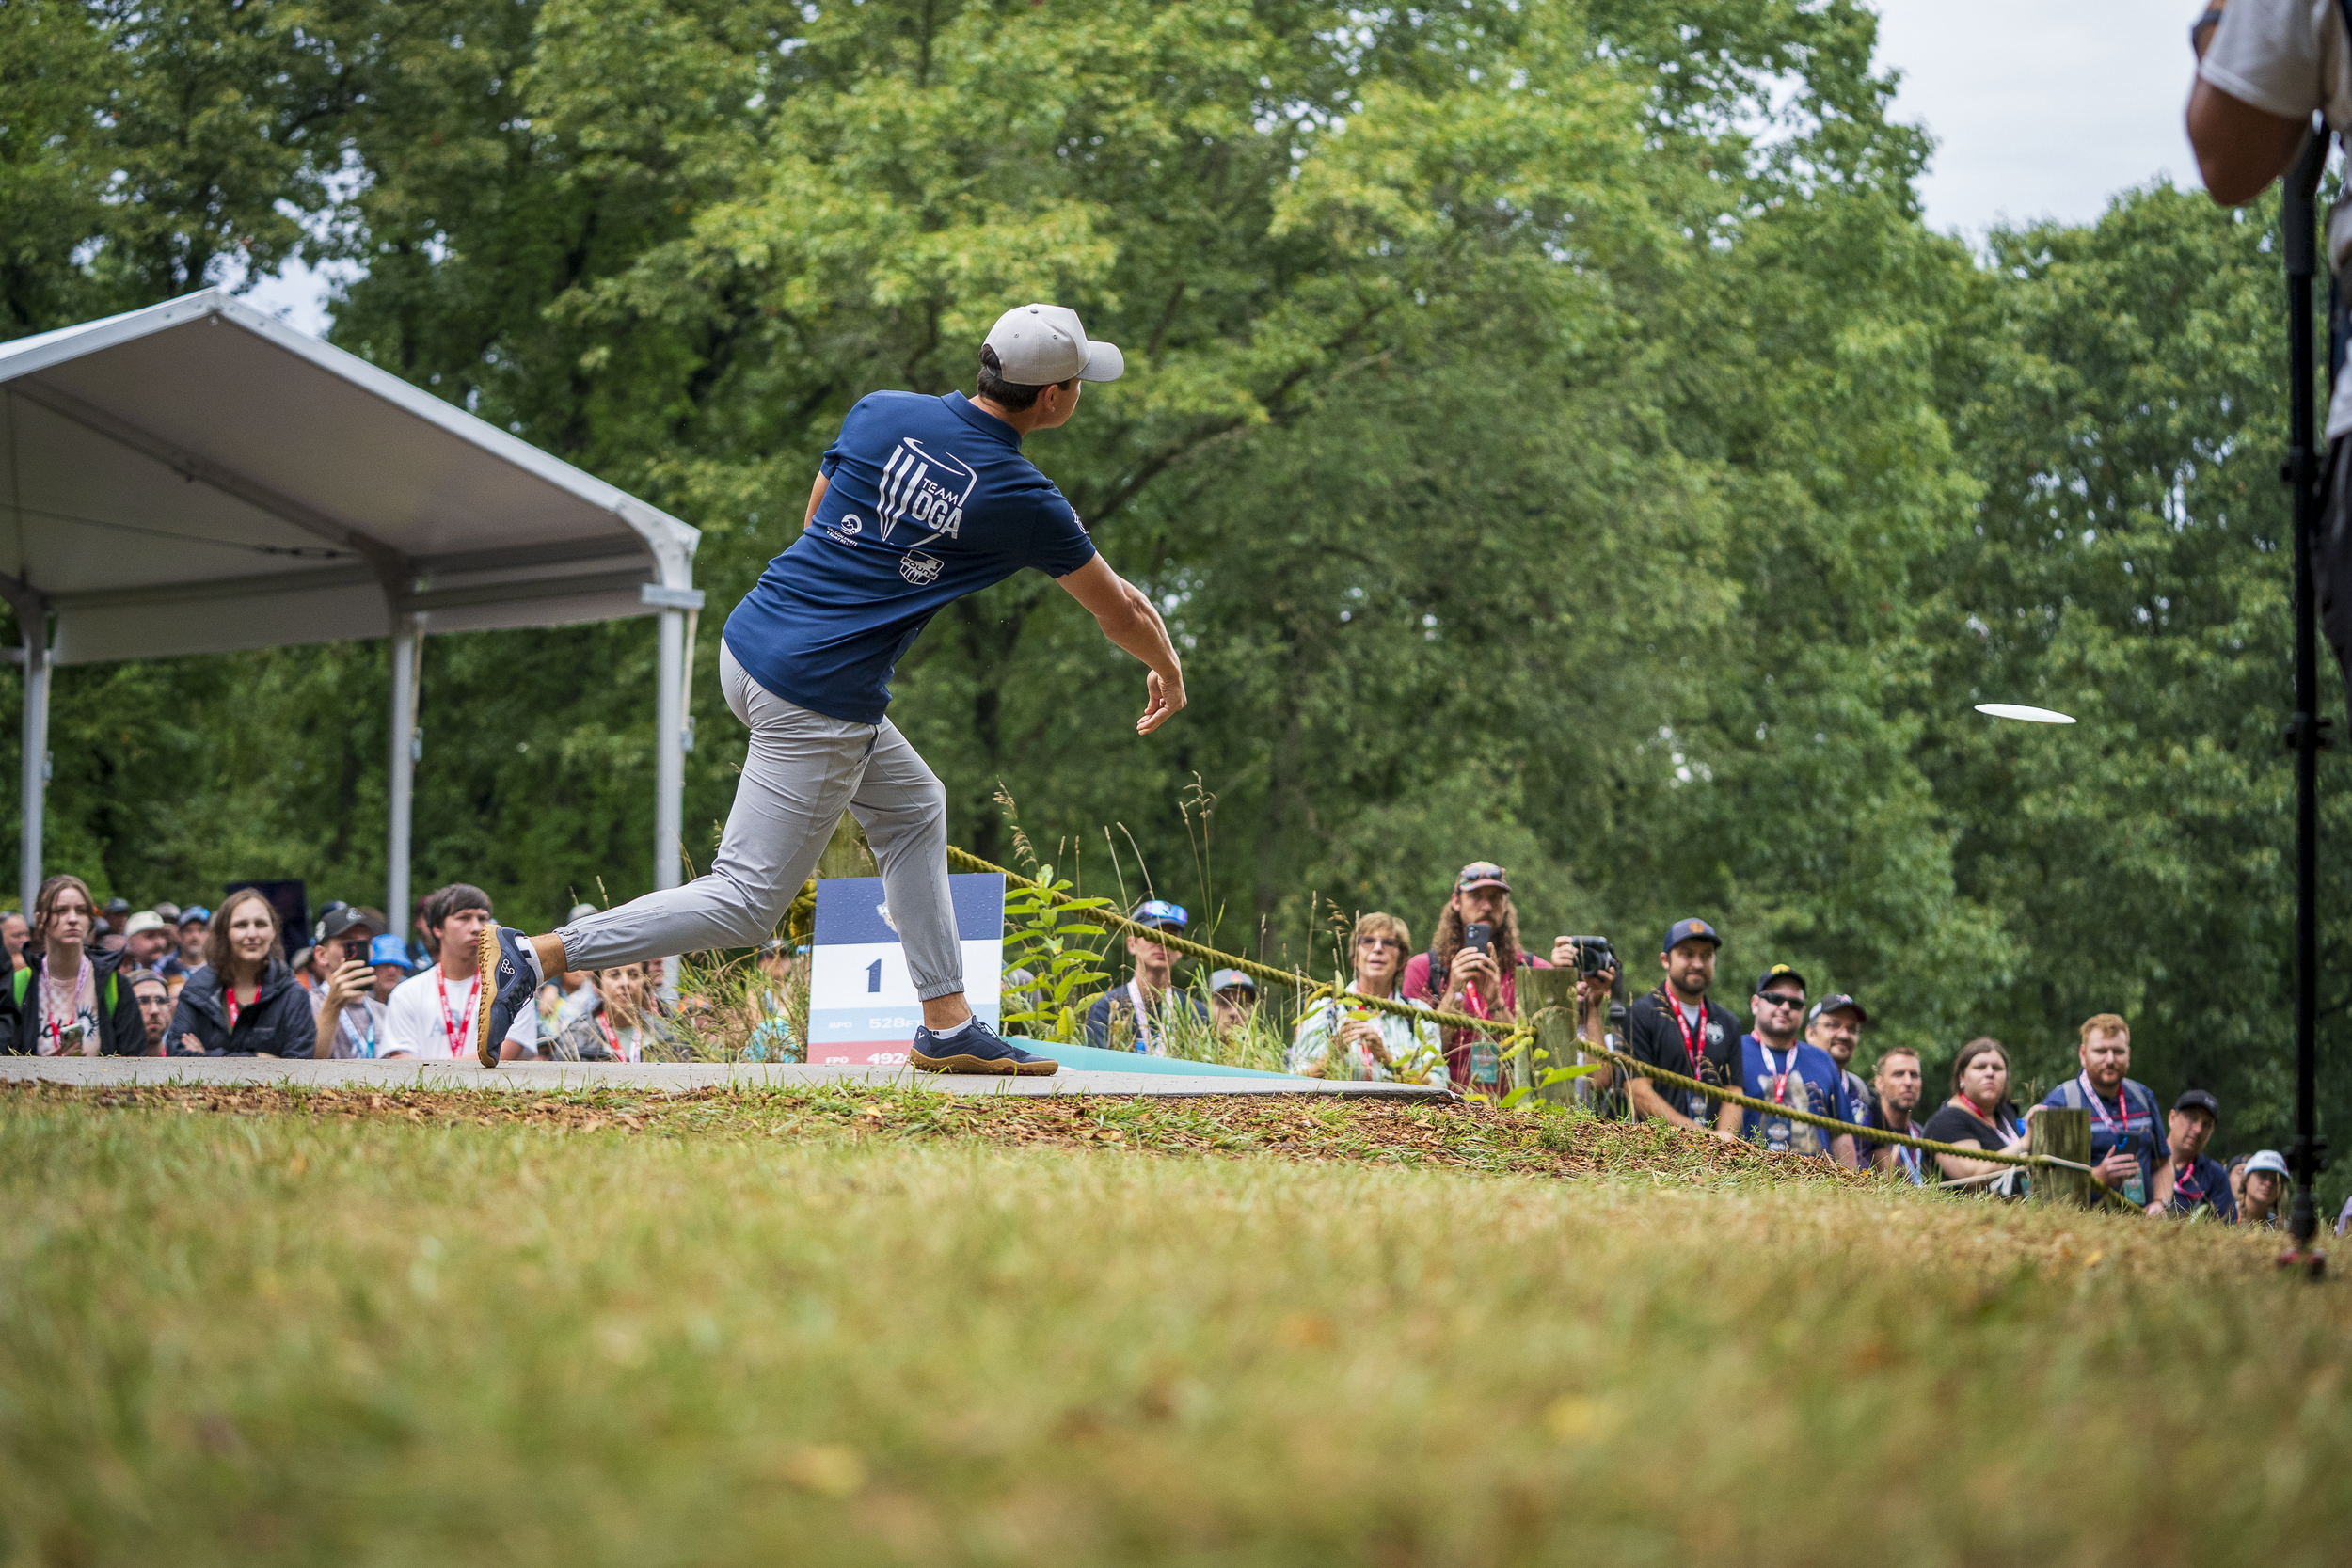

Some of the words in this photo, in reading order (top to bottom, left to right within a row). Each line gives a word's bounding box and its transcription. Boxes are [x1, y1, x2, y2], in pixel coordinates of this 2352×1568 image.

[922, 477, 959, 505] TEAM
[911, 488, 963, 540] DGA
[865, 958, 882, 993] 1
[828, 1021, 853, 1030] MPO
[825, 1056, 850, 1065] FPO
